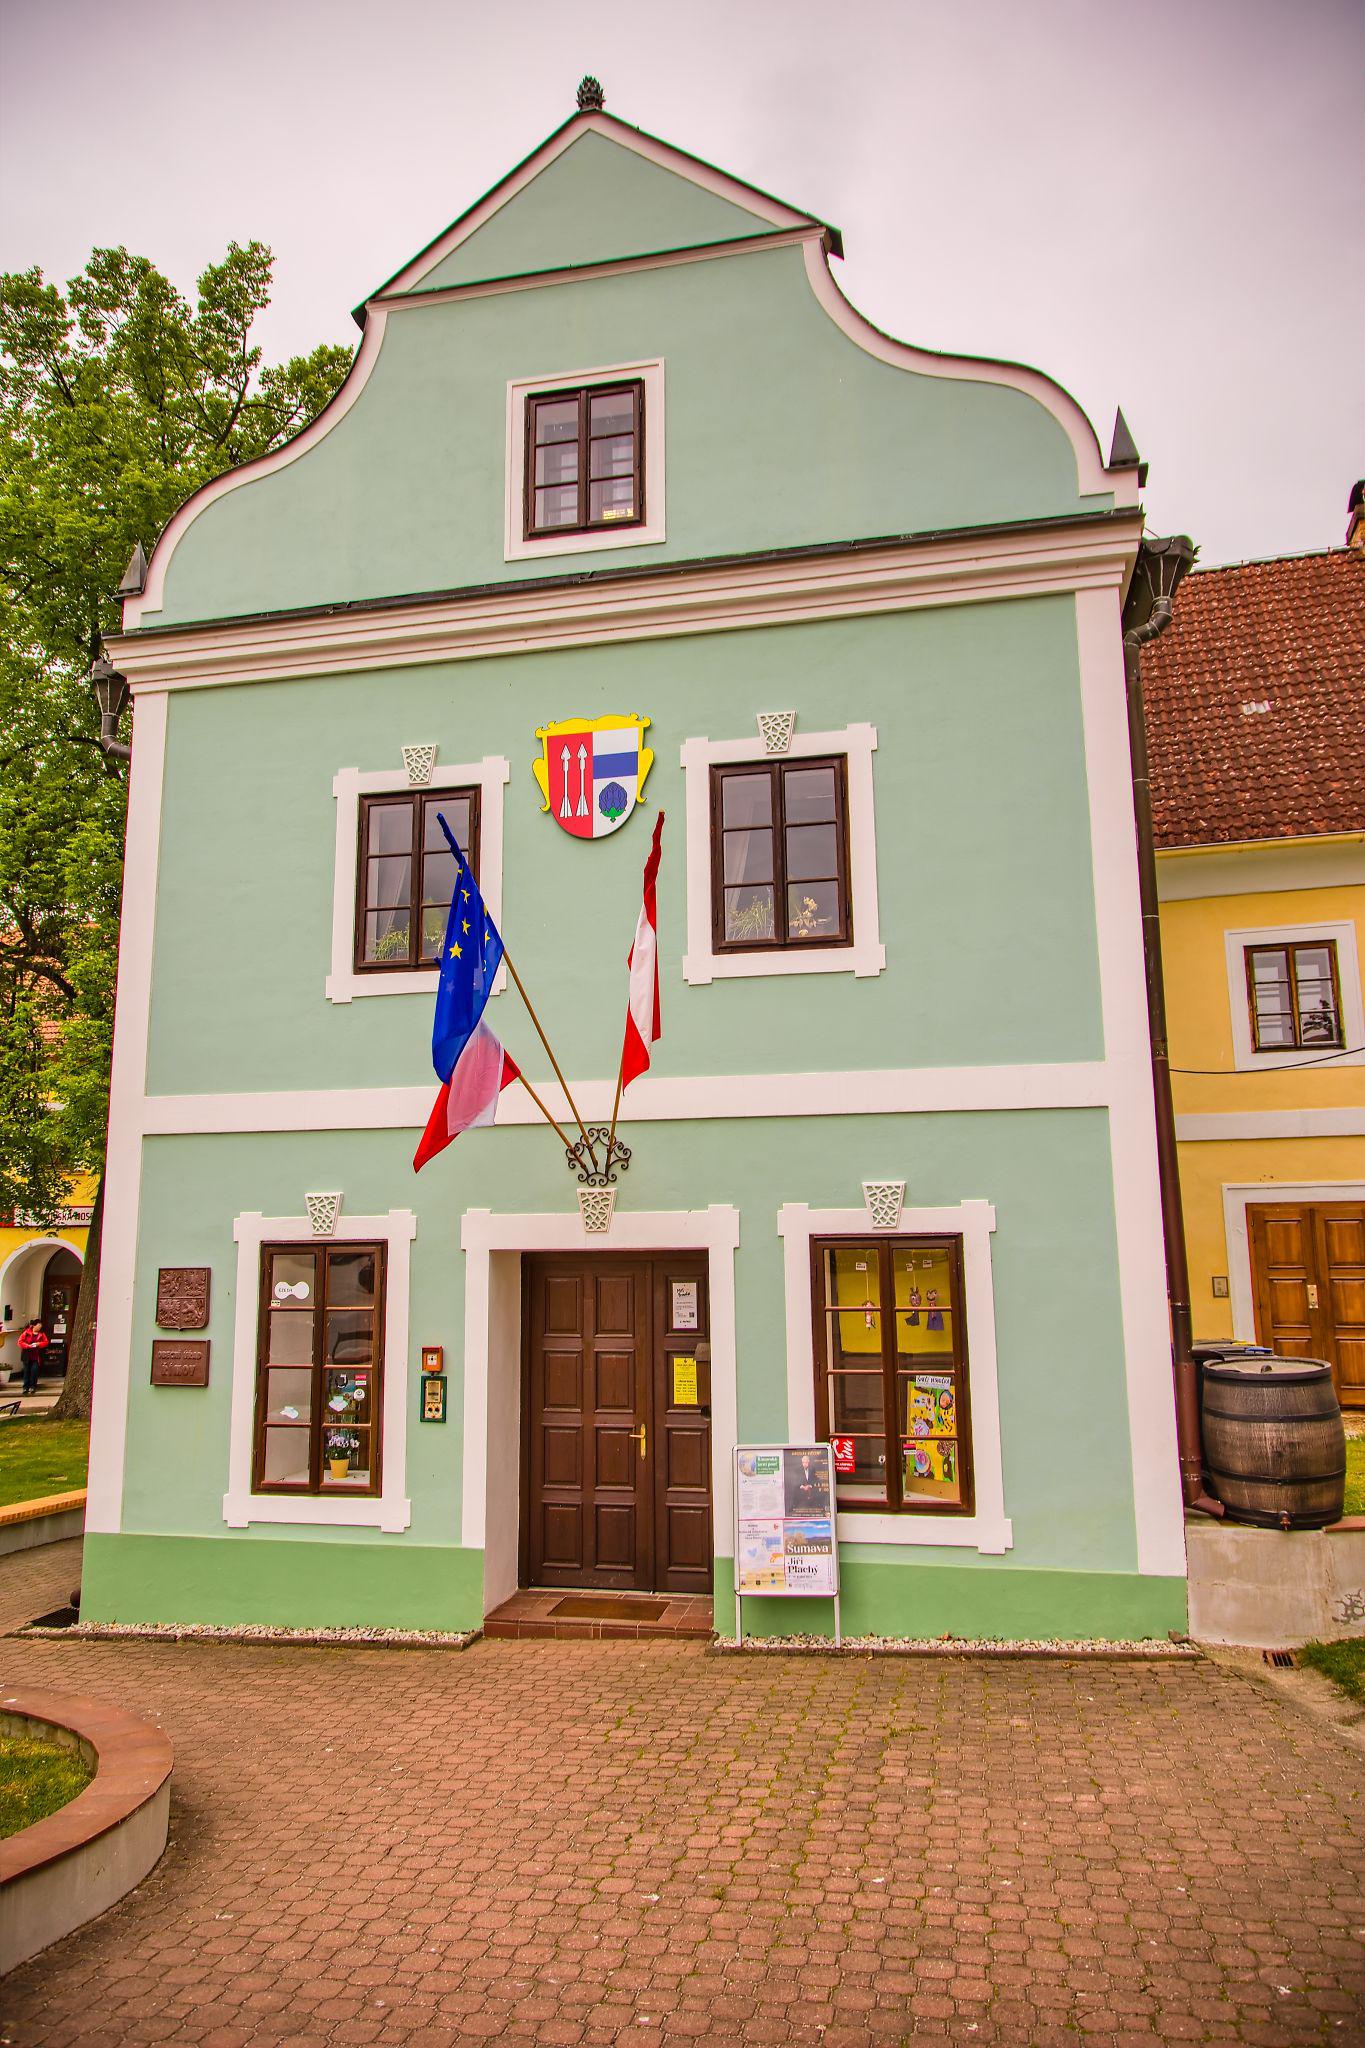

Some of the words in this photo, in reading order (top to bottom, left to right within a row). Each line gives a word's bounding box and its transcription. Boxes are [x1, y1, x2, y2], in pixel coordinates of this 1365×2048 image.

[160, 1361, 196, 1377] ŘÍMOV
[787, 1541, 829, 1554] Šumava
[787, 1557, 803, 1565] Jiří
[788, 1565, 818, 1576] Plachý
